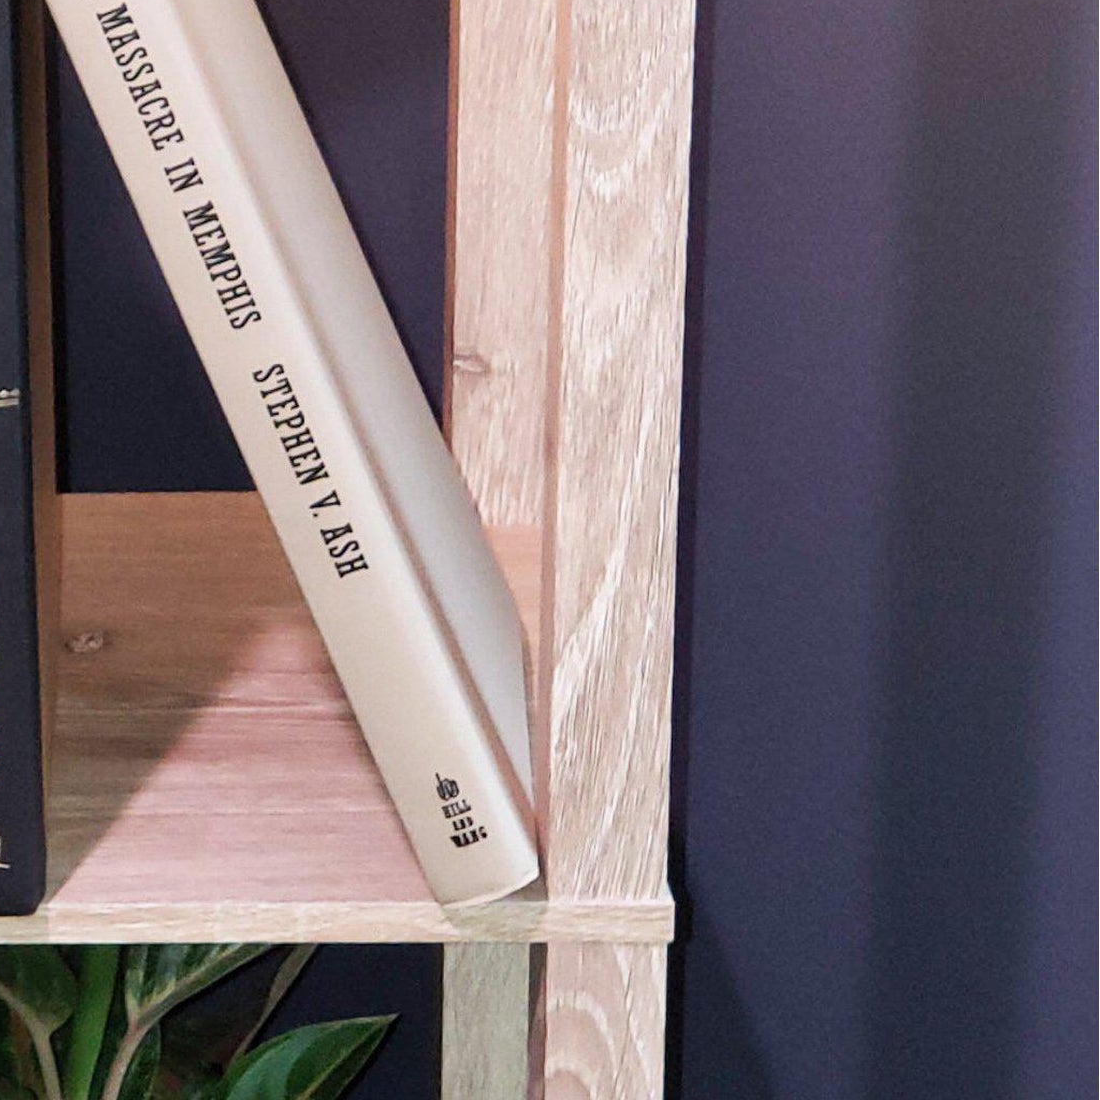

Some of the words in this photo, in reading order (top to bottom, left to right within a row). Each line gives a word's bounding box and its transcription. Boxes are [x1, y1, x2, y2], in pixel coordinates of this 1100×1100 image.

[96, 2, 185, 152] MASSACRE
[164, 157, 204, 194] IN
[183, 200, 262, 330] MEMPHIS
[252, 363, 329, 486] STEPHEN
[309, 490, 342, 519] V.
[320, 522, 370, 579] ASH
